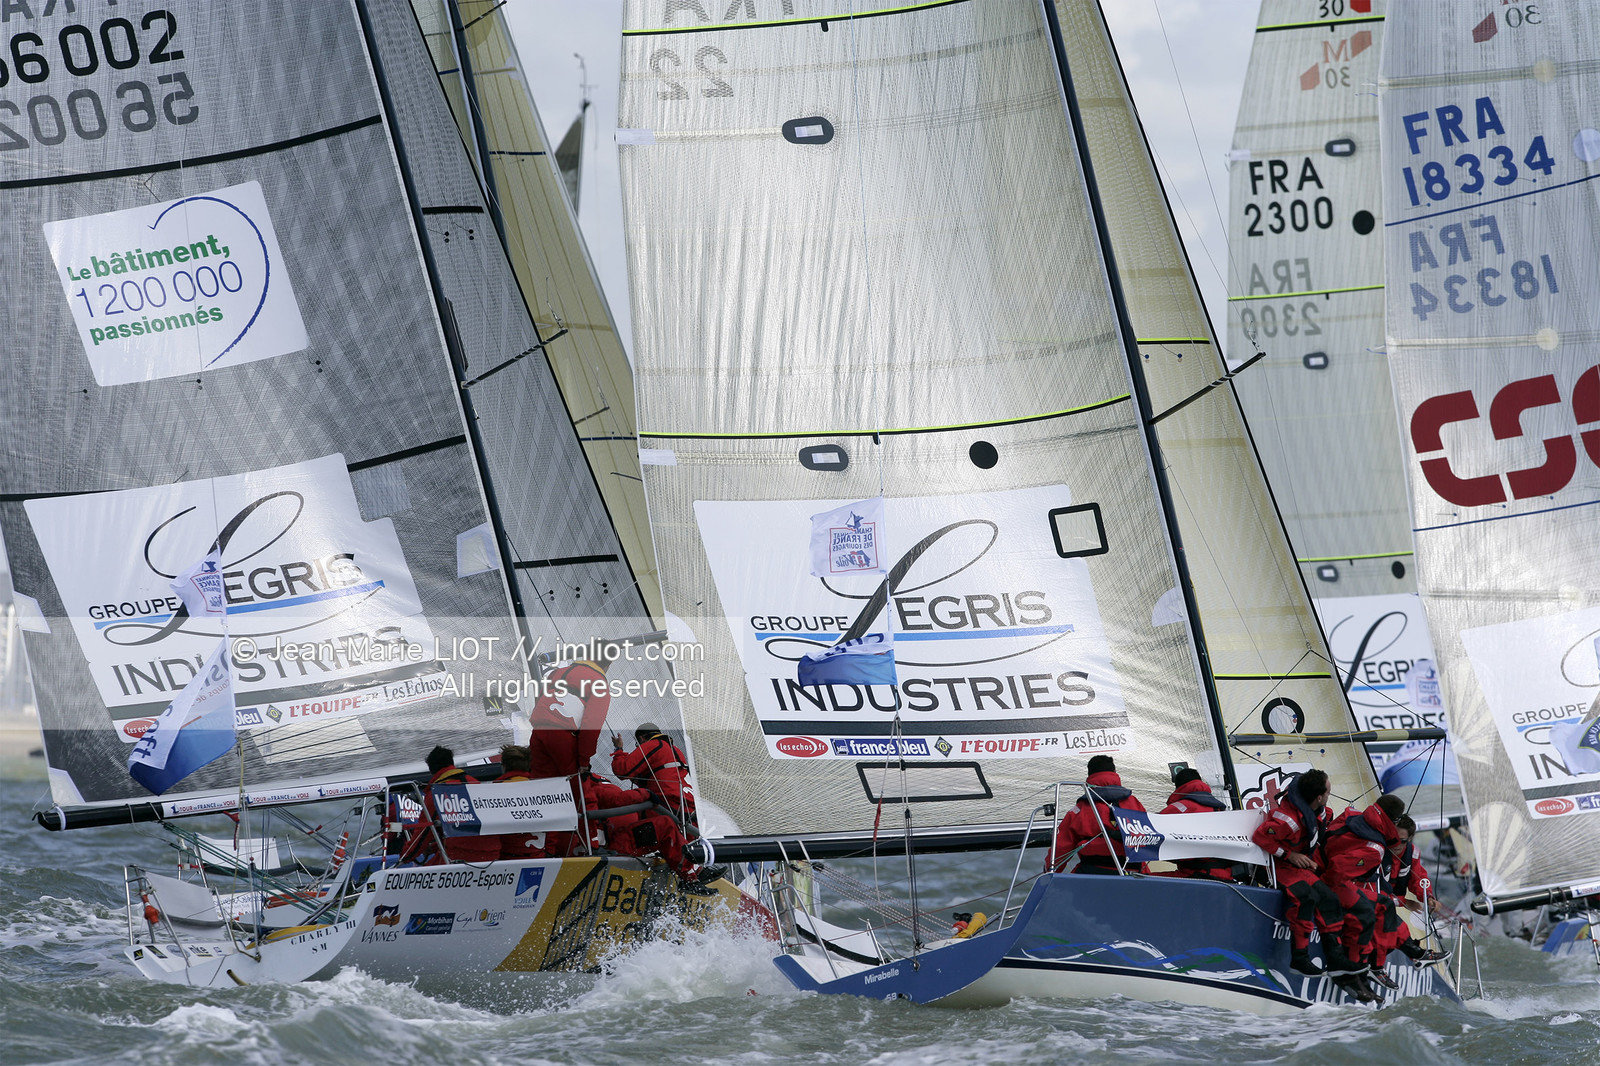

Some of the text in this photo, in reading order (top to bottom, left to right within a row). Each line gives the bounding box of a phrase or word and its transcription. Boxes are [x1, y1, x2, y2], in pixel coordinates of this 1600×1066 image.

[1402, 96, 1505, 155] FRA
[1249, 156, 1324, 195] FRA
[1402, 135, 1555, 207] 18334
[1244, 196, 1334, 237] 2300
[67, 234, 230, 281] Le bâtiment,
[89, 305, 224, 346] passionnés
[88, 595, 179, 620] GROUPE
[750, 615, 849, 631] GROUPE
[1512, 702, 1588, 724] GROUPE
[850, 739, 895, 755] france
[896, 740, 927, 755] bleu
[434, 792, 470, 813] Voile
[518, 797, 529, 806] DU
[530, 792, 572, 806] MORBIHAN
[441, 812, 475, 827] magazine
[511, 809, 543, 820] ESPOIRS
[385, 872, 437, 890] EQUIPAGE
[360, 926, 399, 943] VANNES
[864, 968, 900, 984] Mirabelle
